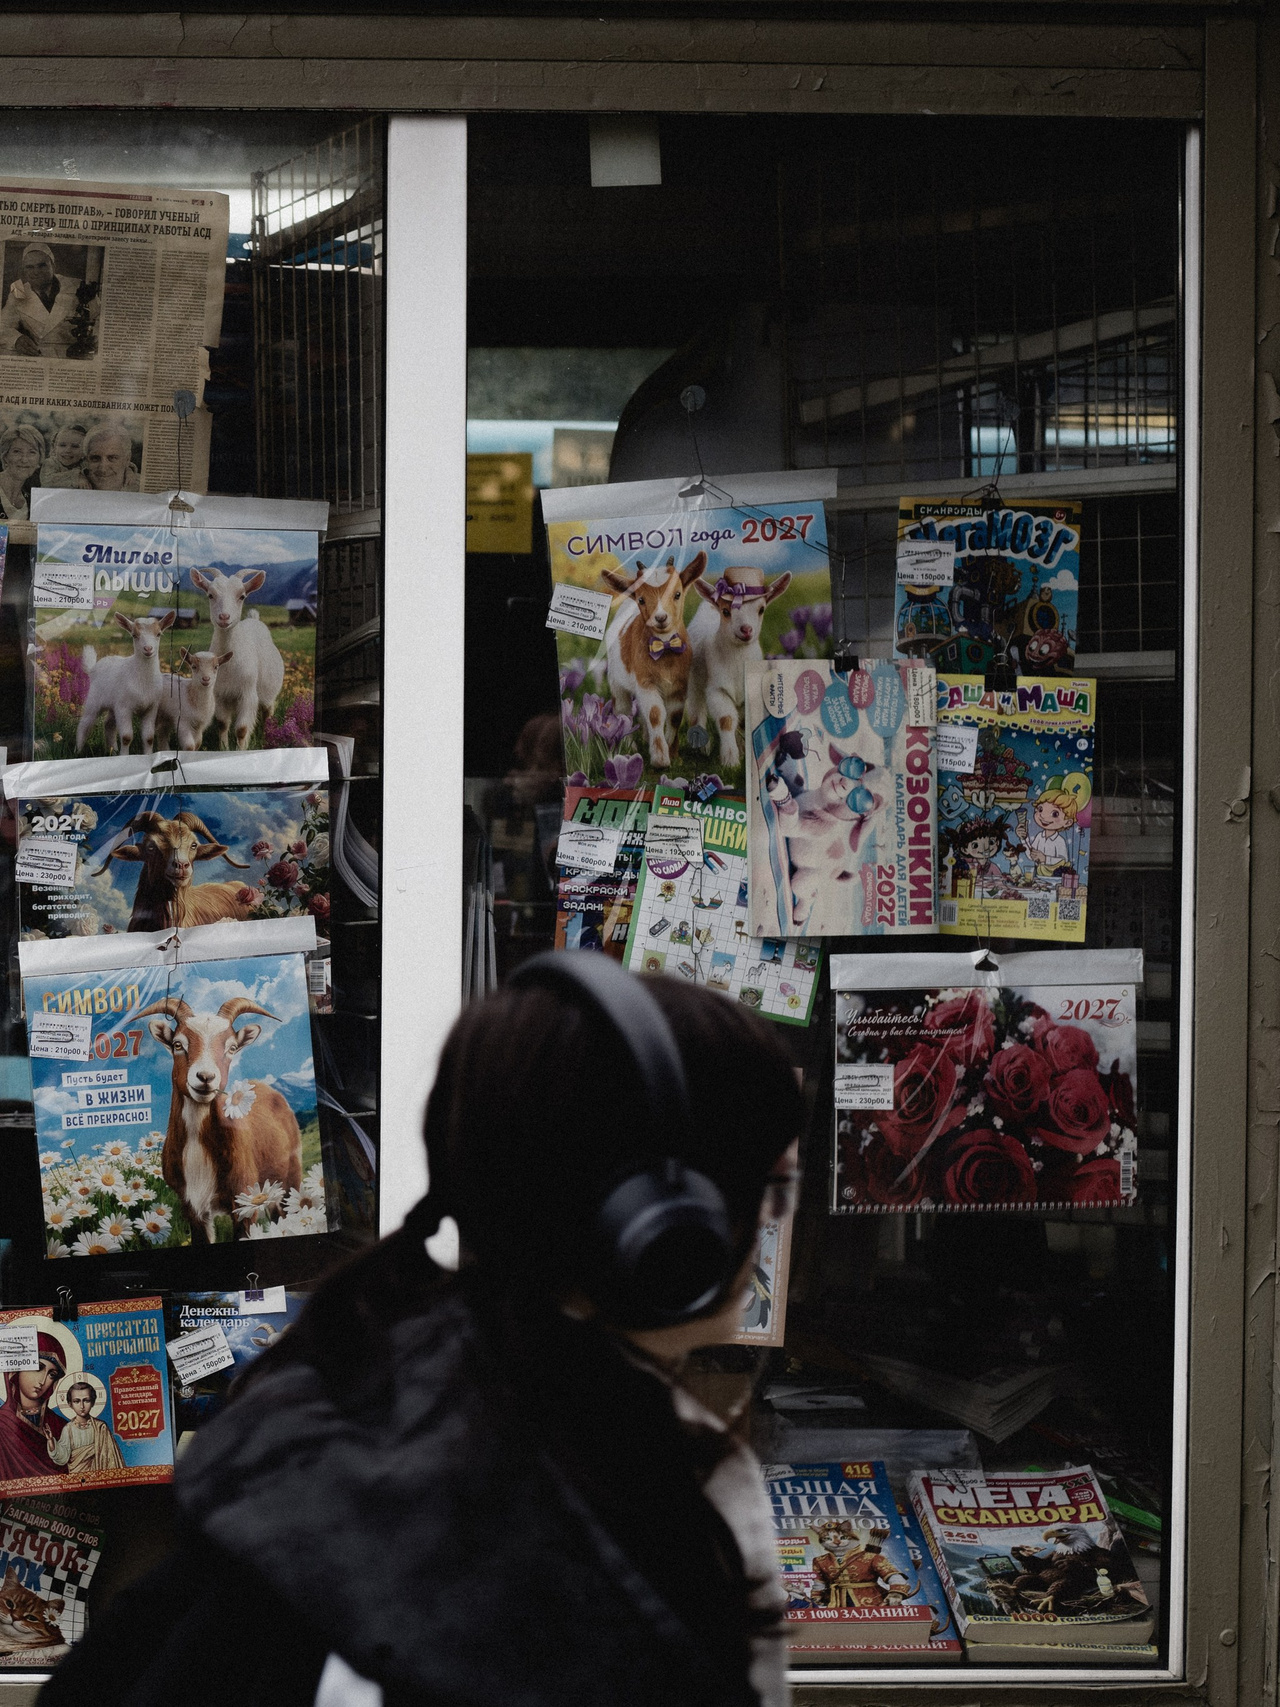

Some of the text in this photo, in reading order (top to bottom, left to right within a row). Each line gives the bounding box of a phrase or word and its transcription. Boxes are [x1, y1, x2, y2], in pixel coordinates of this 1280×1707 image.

[20, 202, 56, 214] СМЕРТЬ
[58, 204, 105, 218] ПОПРАВ»,
[114, 208, 156, 220] ГОВОРИЛ
[159, 210, 200, 223] УЧЕНЫЙ
[0, 215, 31, 229] КОГДА
[32, 217, 57, 228] РЕЧЬ
[58, 218, 80, 229] ШЛА
[82, 219, 89, 230] О
[90, 220, 151, 235] ПРИНЦИПАХ
[152, 224, 192, 236] РАБОТЫ
[194, 227, 212, 240] АСД
[5, 395, 20, 405] АСД
[29, 397, 45, 406] ПРИ
[46, 398, 73, 408] КАКИХ
[73, 400, 132, 412] ЗАБОЛЕВАНИЯХ
[133, 402, 160, 413] МОЖЕТ
[567, 515, 814, 556] СИМВОЛ года 2027
[82, 543, 173, 565] Милые
[547, 615, 566, 626] Цена
[1017, 685, 1089, 714] МАША
[661, 796, 680, 807] Лиза
[31, 815, 84, 832] 2027
[906, 726, 934, 926] КОЗОЧКИН
[65, 833, 86, 841] ГОДА
[894, 773, 910, 926] КАЛЕНДАРЬ ДЛЯ ДЕТЕЙ
[48, 893, 93, 902] приходит,
[563, 884, 628, 896] РАСКРАСКИ
[876, 865, 896, 927] 2027
[32, 903, 78, 911] богатство
[48, 912, 90, 920] приводит
[43, 985, 141, 1015] СИМВОЛ
[845, 1007, 927, 1026] Улыбайтесь!
[1058, 998, 1122, 1021] 2027
[847, 1026, 880, 1038] Сегодня
[890, 1026, 904, 1036] вас
[905, 1026, 917, 1036] все
[89, 1030, 144, 1061] 027
[66, 1072, 124, 1087] Пусть будет
[86, 1088, 145, 1107] В ЖИЗНИ
[859, 1097, 885, 1106] 230р00
[66, 1110, 149, 1127] ВСЁ ПРЕКРАСНО!
[179, 1305, 238, 1319] Денежны
[113, 1383, 159, 1394] Православный
[120, 1391, 153, 1400] календарь
[117, 1408, 161, 1434] 2027
[844, 1463, 871, 1475] 416
[932, 1484, 1069, 1509] МЕГА
[936, 1503, 1105, 1525] СКАНВОРД
[9, 1506, 99, 1547] ЗАГАДАНО 8000 СЛОВ
[943, 1530, 979, 1540] 340
[810, 1605, 919, 1619] 1000 ЗАДАНИЙ!
[1012, 1612, 1058, 1623] 1000
